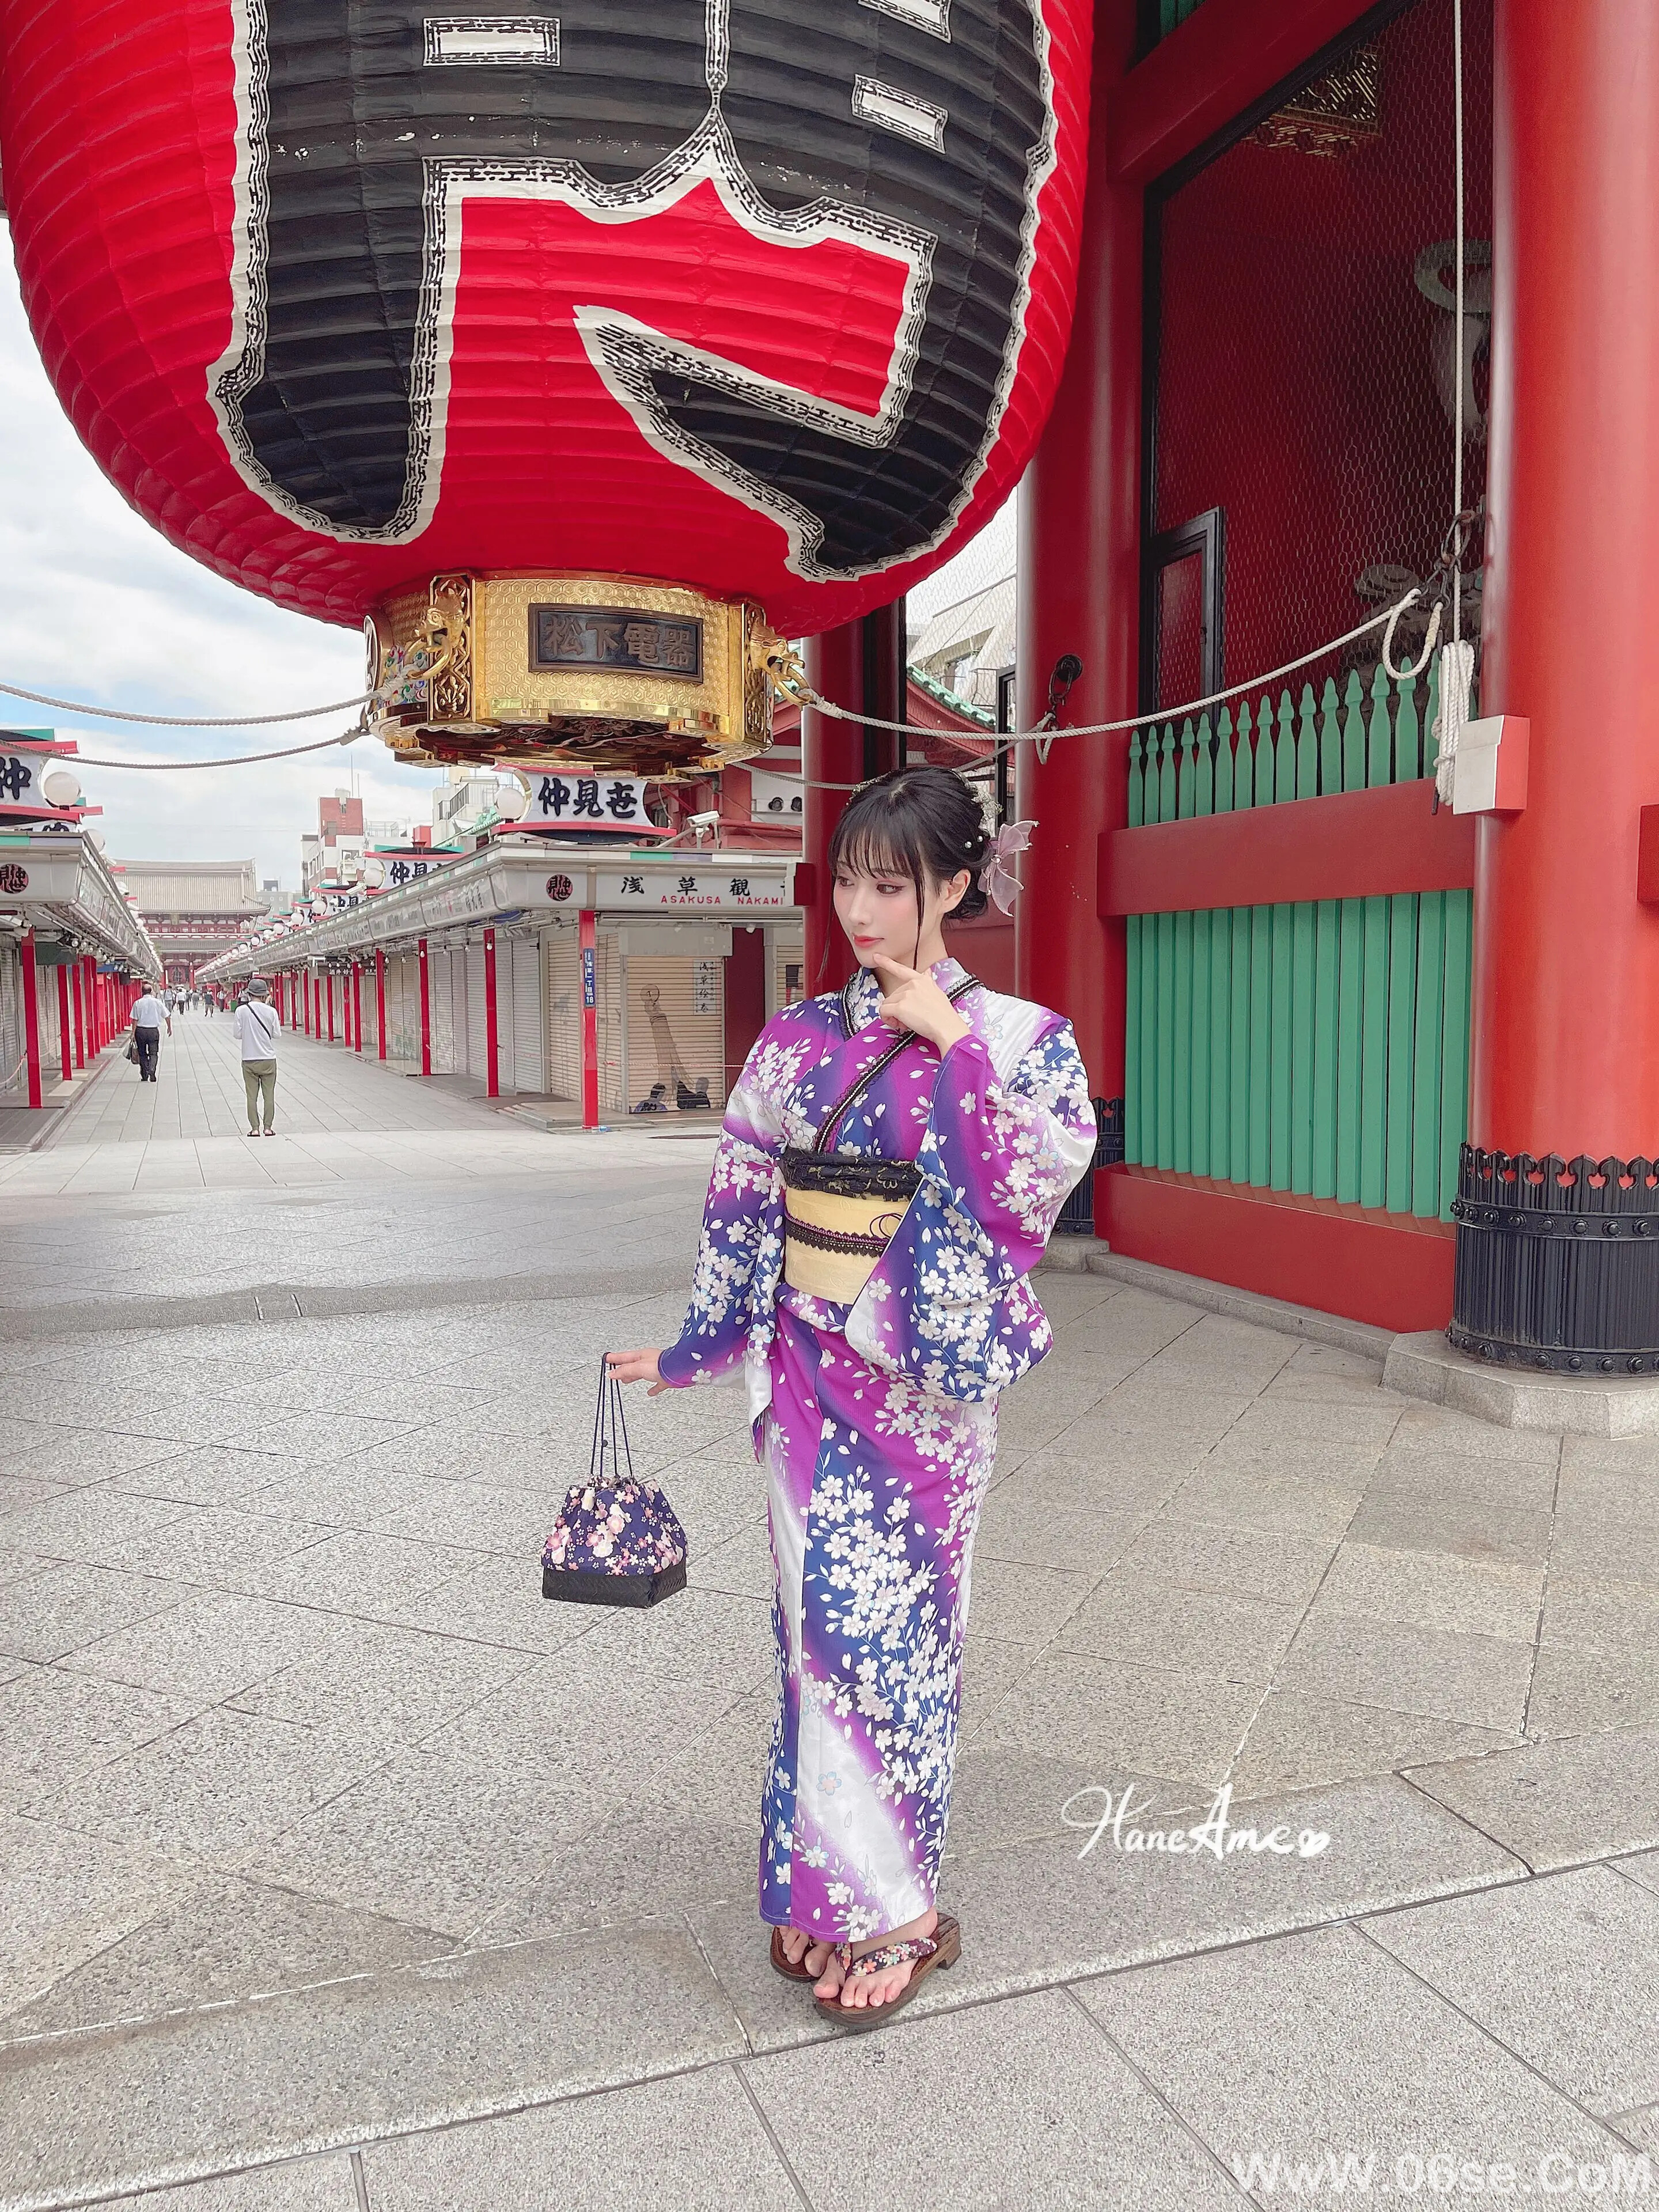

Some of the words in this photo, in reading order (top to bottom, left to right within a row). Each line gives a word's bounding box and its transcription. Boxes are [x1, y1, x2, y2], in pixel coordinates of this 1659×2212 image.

[544, 615, 696, 666] 松下電器
[538, 777, 638, 819] 仲見世
[390, 861, 445, 884] 仲見
[620, 876, 785, 896] 浅草観
[661, 896, 721, 904] ASAKUSA
[737, 897, 783, 906] NAKAMI
